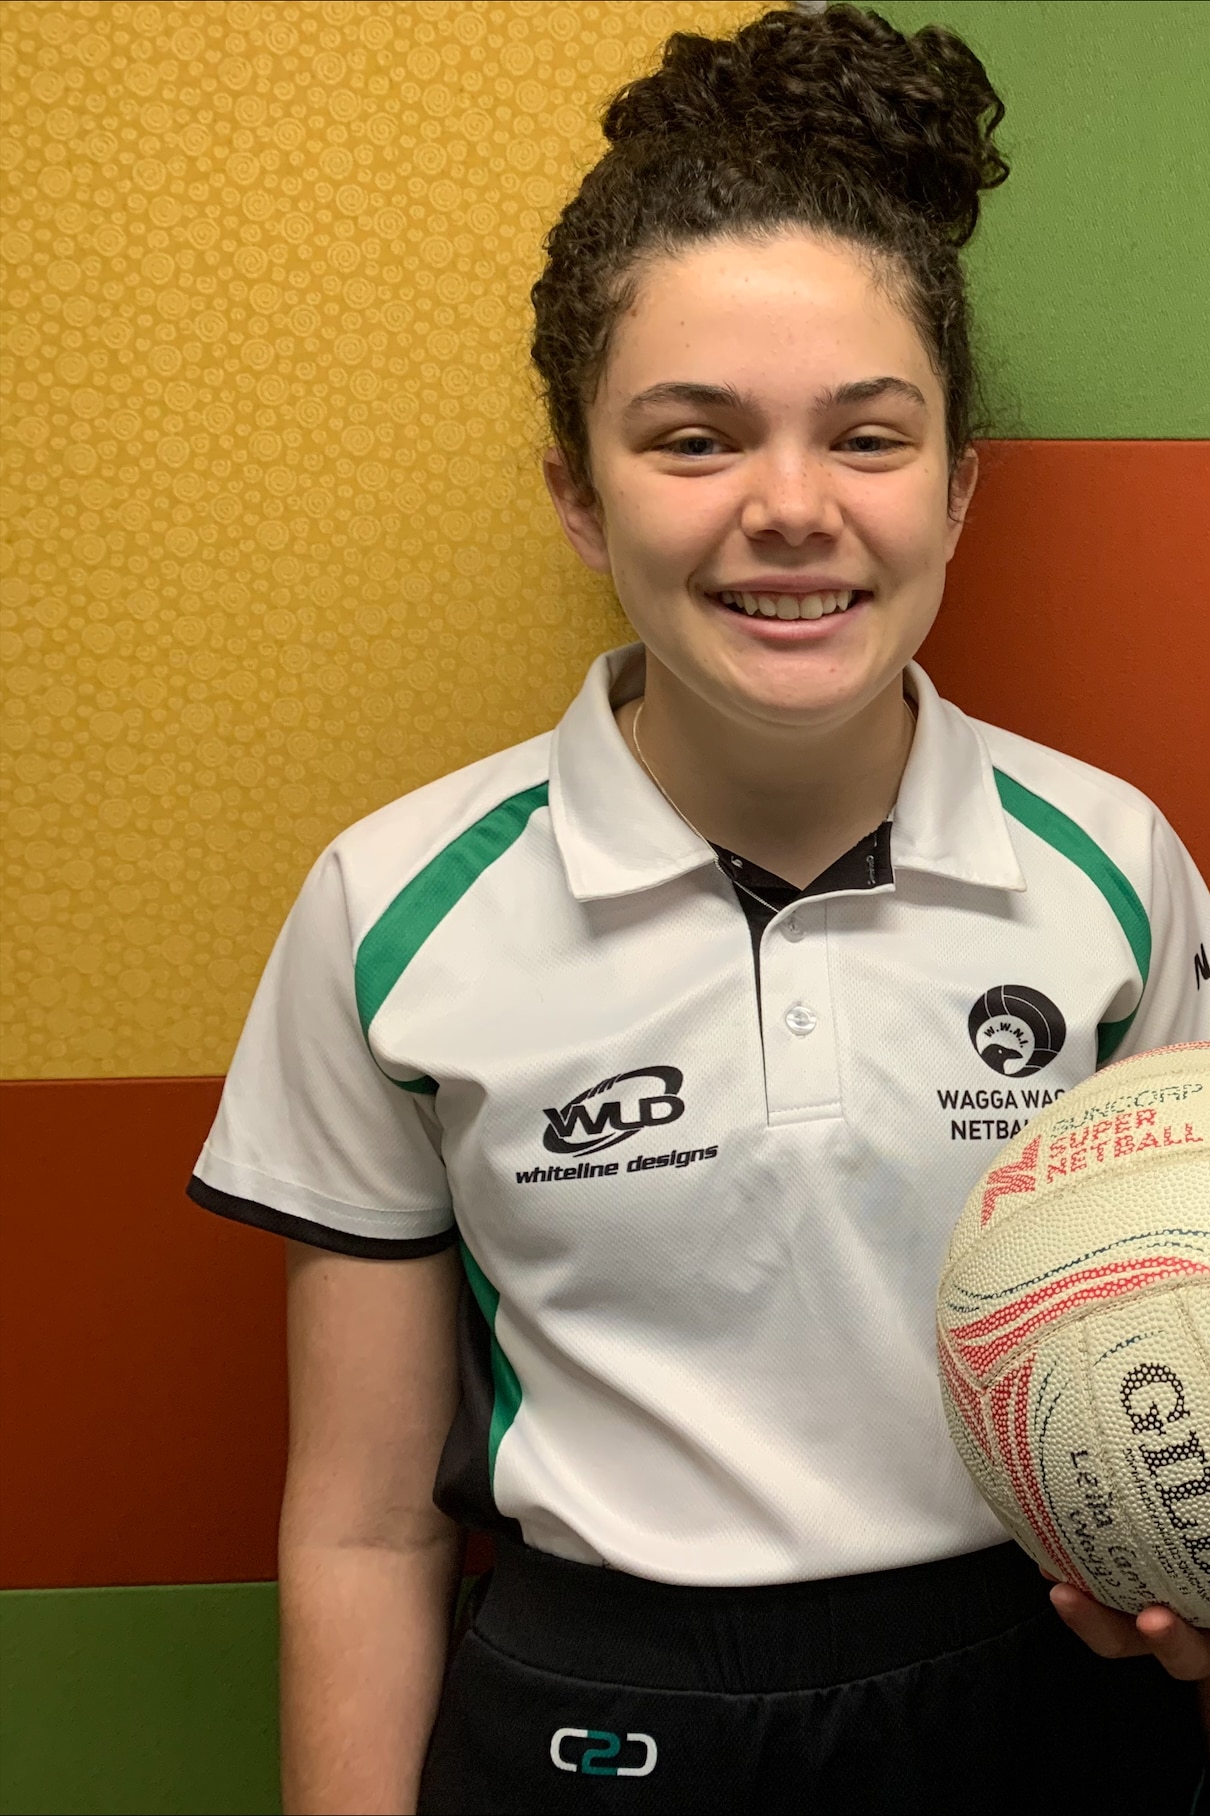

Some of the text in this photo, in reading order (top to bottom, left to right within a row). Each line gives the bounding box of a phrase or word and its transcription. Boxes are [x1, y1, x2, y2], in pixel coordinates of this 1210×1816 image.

[936, 1089, 1019, 1110] WAGGA
[950, 1119, 1029, 1141] NETBA
[1049, 1108, 1158, 1160] SUPER
[515, 1144, 719, 1184] whiteline designs
[1046, 1122, 1205, 1185] NETBALL
